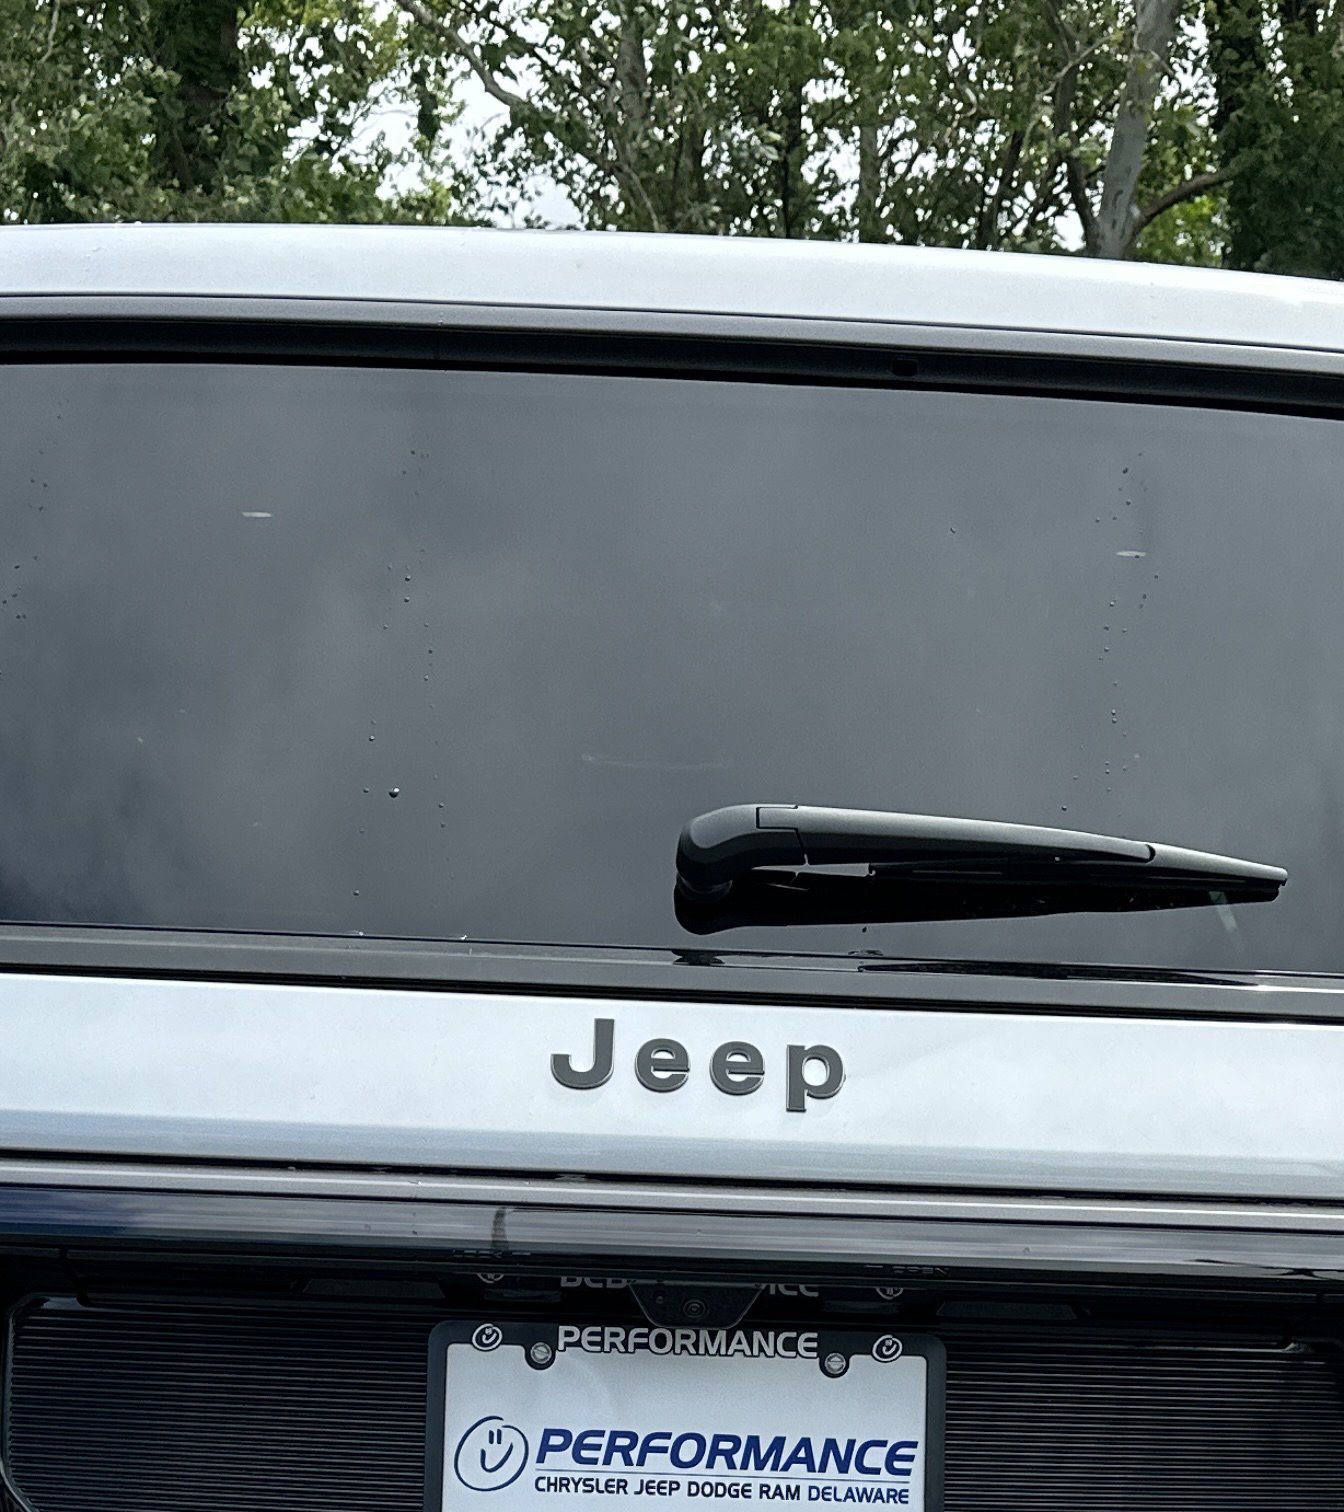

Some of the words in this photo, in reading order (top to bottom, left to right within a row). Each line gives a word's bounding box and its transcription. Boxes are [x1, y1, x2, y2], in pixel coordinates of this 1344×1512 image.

[550, 1017, 845, 1113] Jeep
[556, 1324, 819, 1359] PERFORMANCE
[536, 1428, 918, 1476] PERFORMANCE
[534, 1475, 629, 1496] CHRYSLER
[634, 1479, 682, 1497] JEEP
[687, 1481, 753, 1500] DODGE
[759, 1483, 802, 1501] RAM
[807, 1485, 910, 1505] DELAWARE
